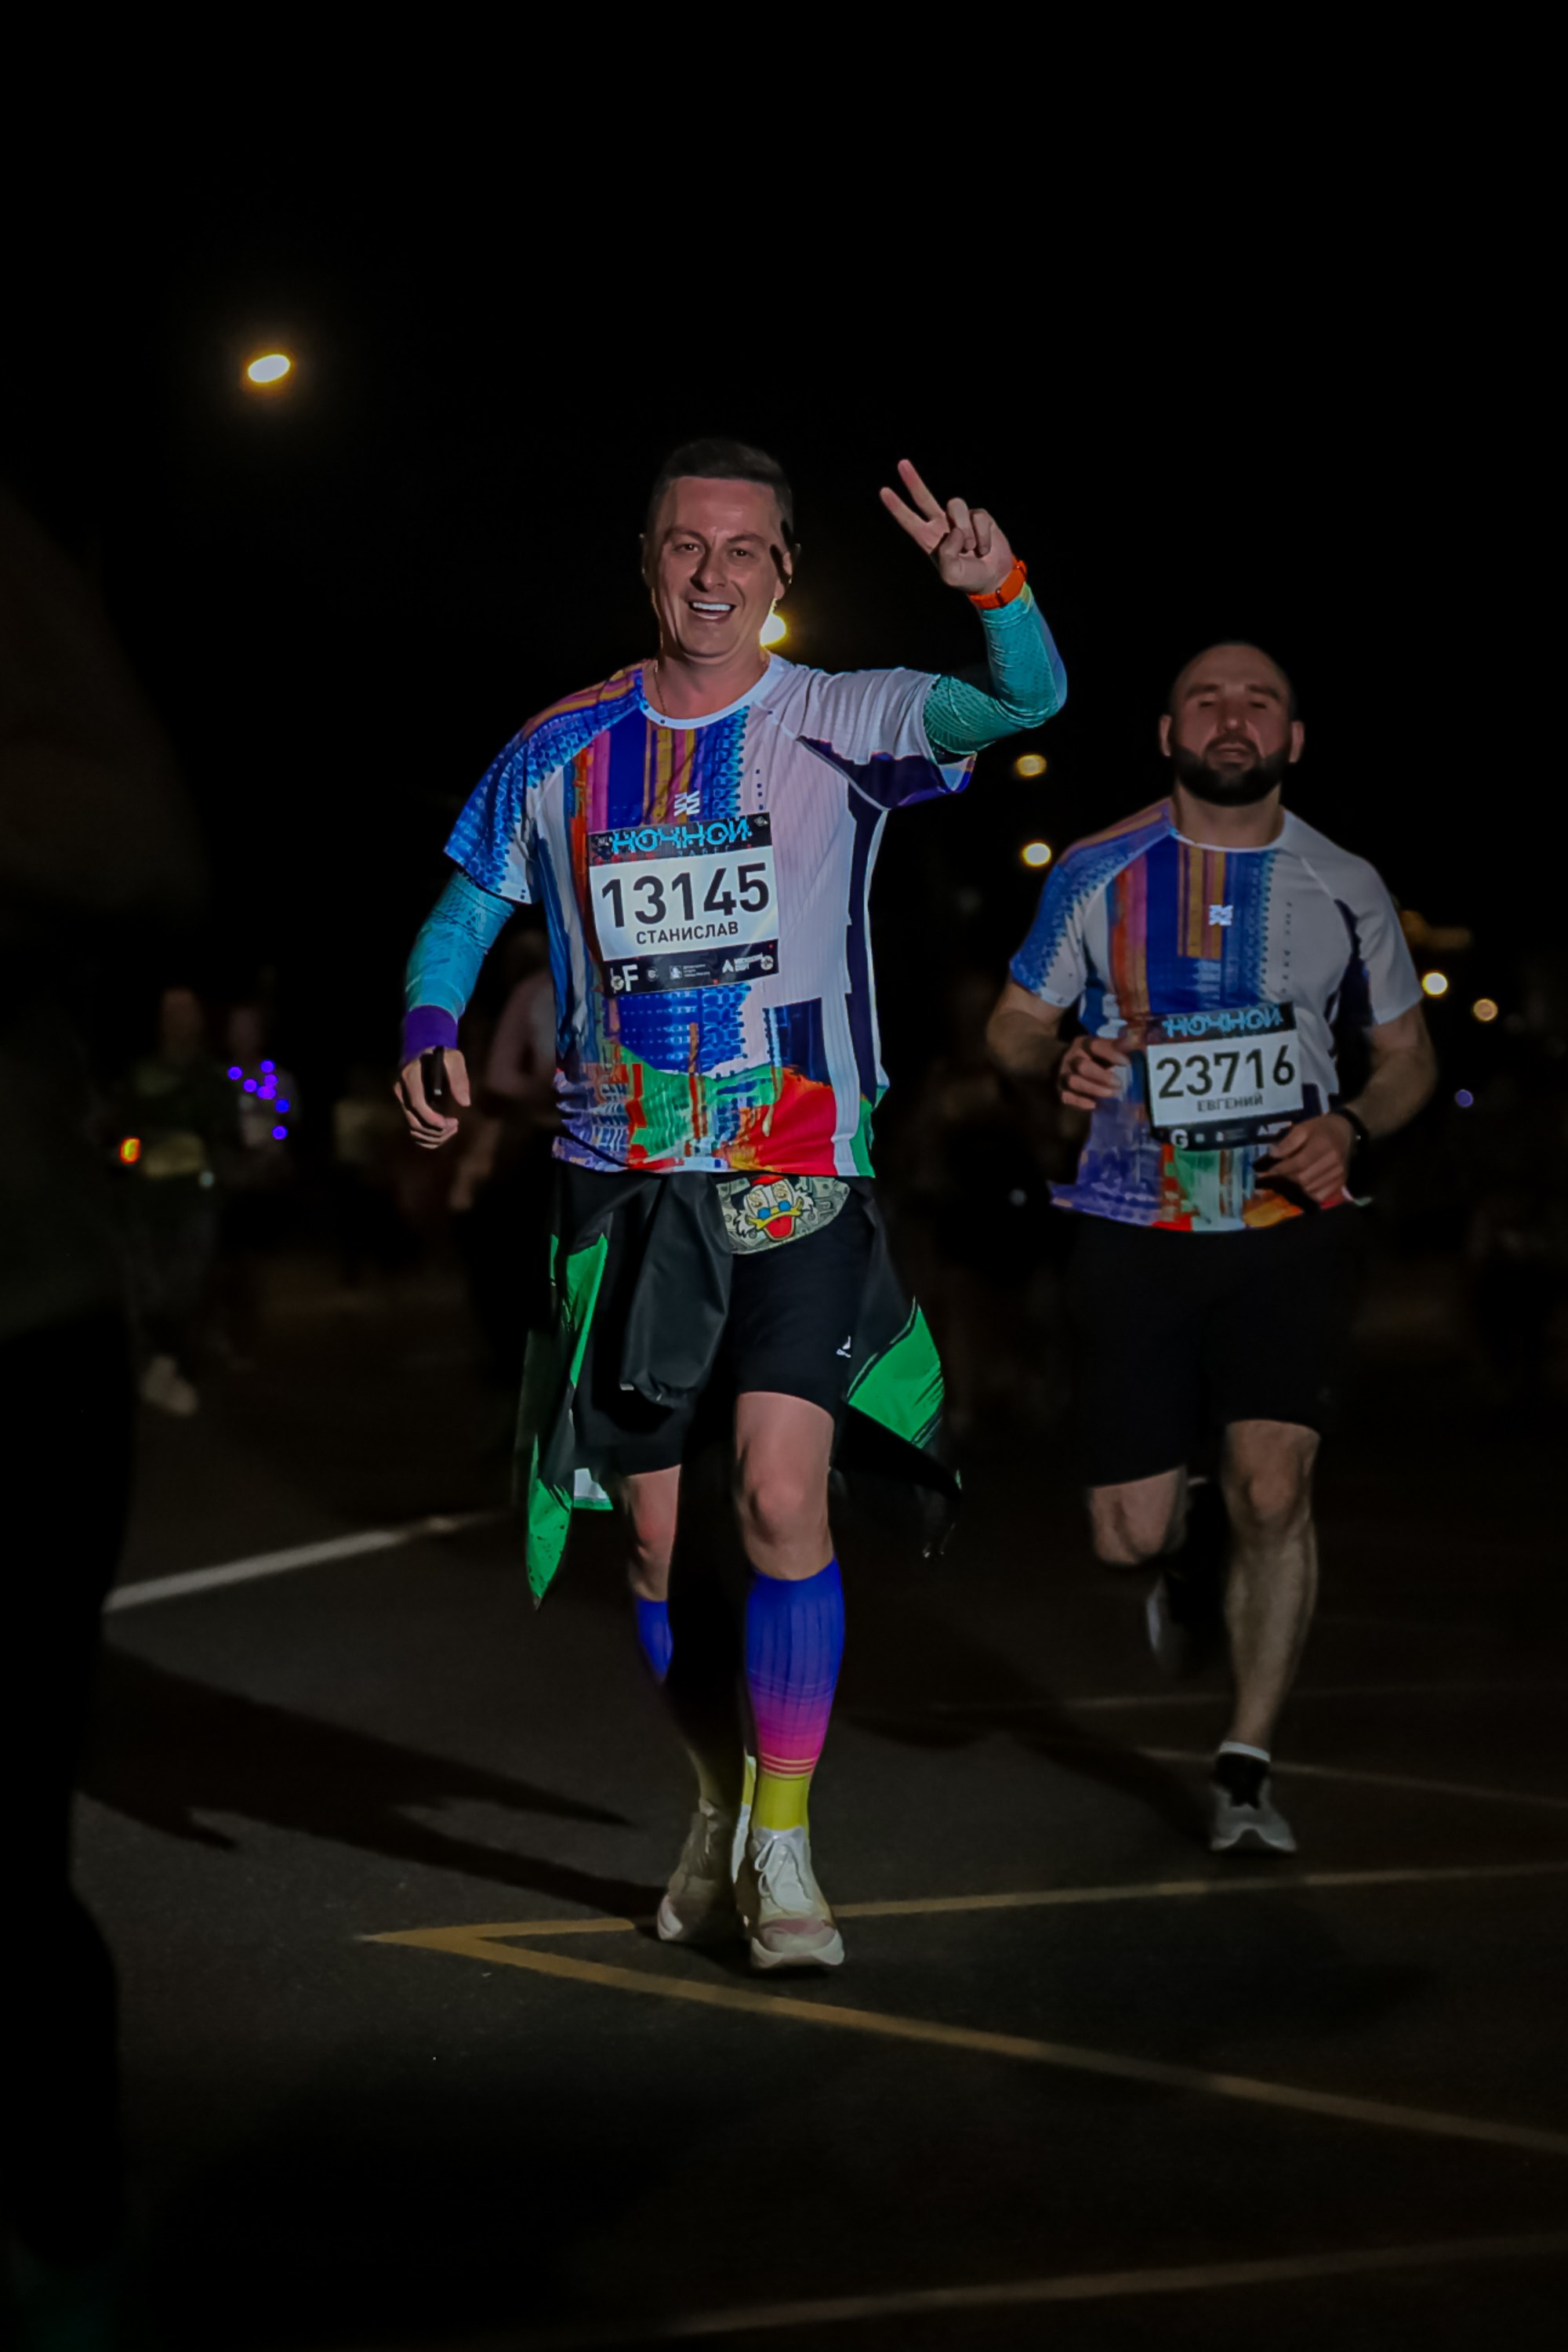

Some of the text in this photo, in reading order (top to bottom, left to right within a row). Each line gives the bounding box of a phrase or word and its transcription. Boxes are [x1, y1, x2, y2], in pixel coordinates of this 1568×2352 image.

[610, 818, 753, 854] НОЧНОЙ
[601, 862, 769, 928] 13145
[636, 921, 739, 945] СТАНИСЛАВ
[622, 964, 639, 992] F
[1156, 1044, 1295, 1098] 23716
[1197, 1093, 1264, 1112] ЕВГЕНИЙ
[1171, 1129, 1189, 1149] G
